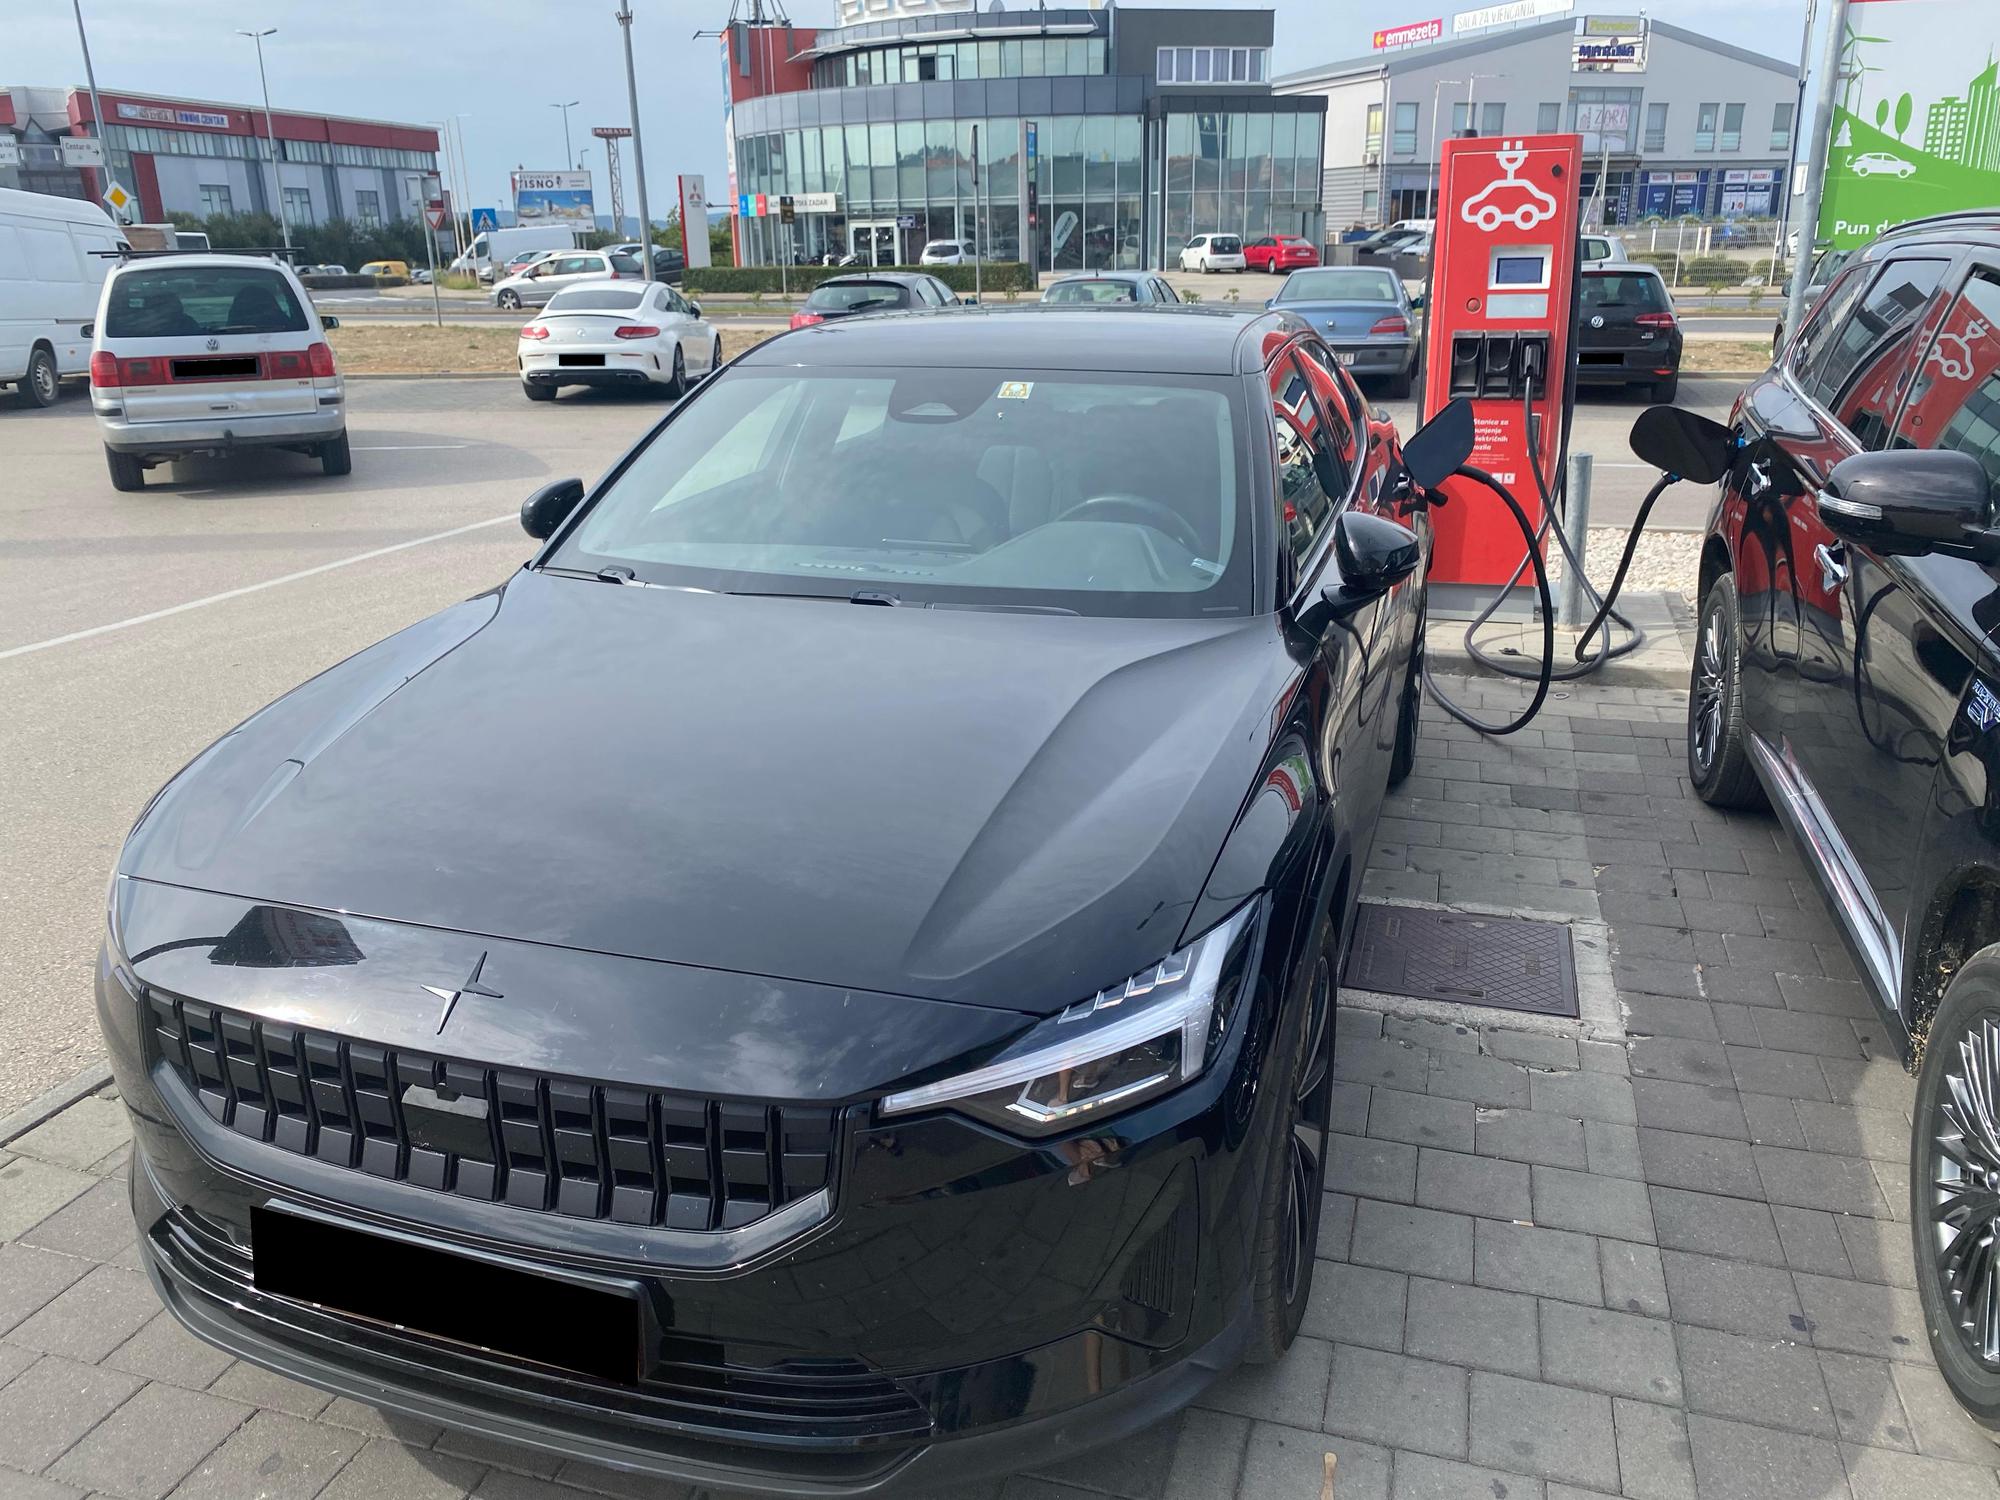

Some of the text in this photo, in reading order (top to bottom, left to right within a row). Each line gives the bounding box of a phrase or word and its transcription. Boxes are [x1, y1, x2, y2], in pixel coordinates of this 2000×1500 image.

[1457, 14, 1477, 29] SALA
[1478, 11, 1489, 25] ZA
[1385, 22, 1439, 46] emmezeta
[1579, 39, 1635, 57] MARINA
[1834, 220, 1870, 235] Pun
[1474, 418, 1498, 426] Stanica
